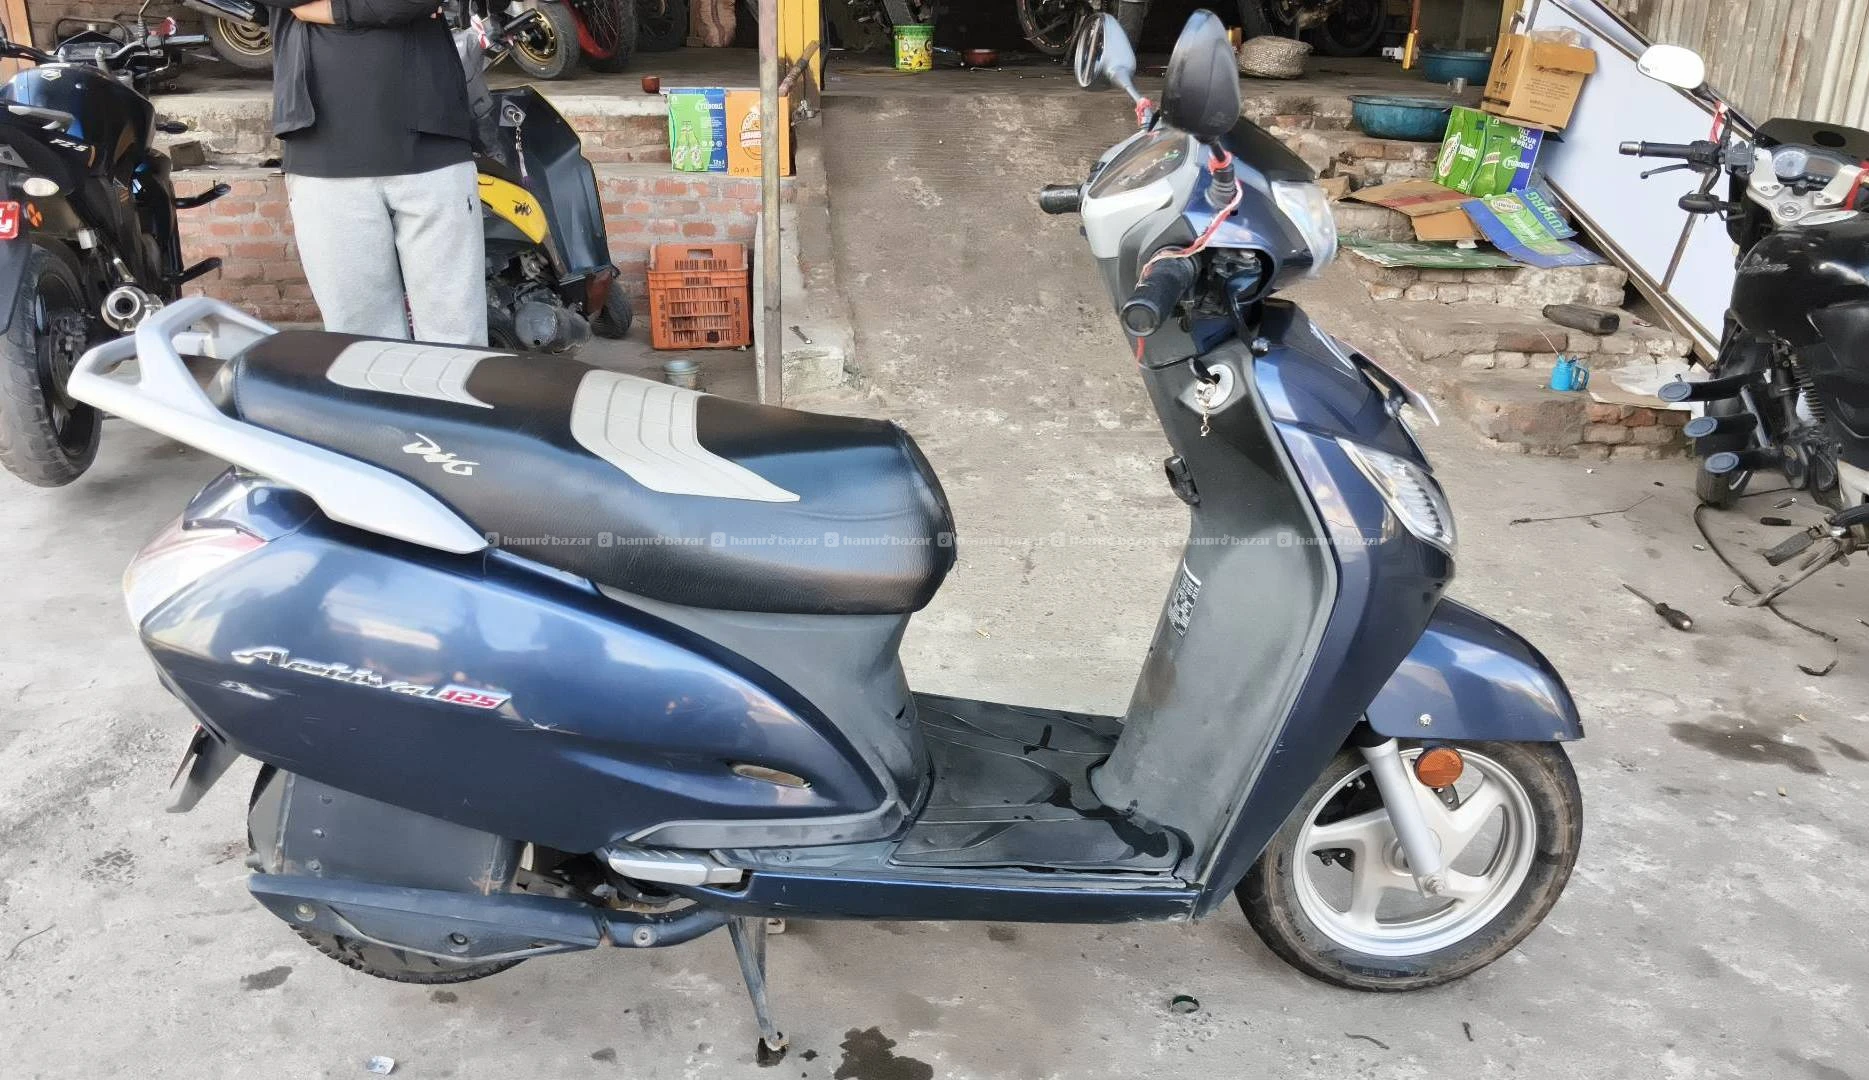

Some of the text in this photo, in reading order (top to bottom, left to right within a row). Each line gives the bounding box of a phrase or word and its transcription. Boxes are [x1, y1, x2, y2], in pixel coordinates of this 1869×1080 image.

[1519, 133, 1537, 145] YOUR
[1525, 192, 1568, 236] TUBORG
[232, 646, 503, 709] Activa 125
